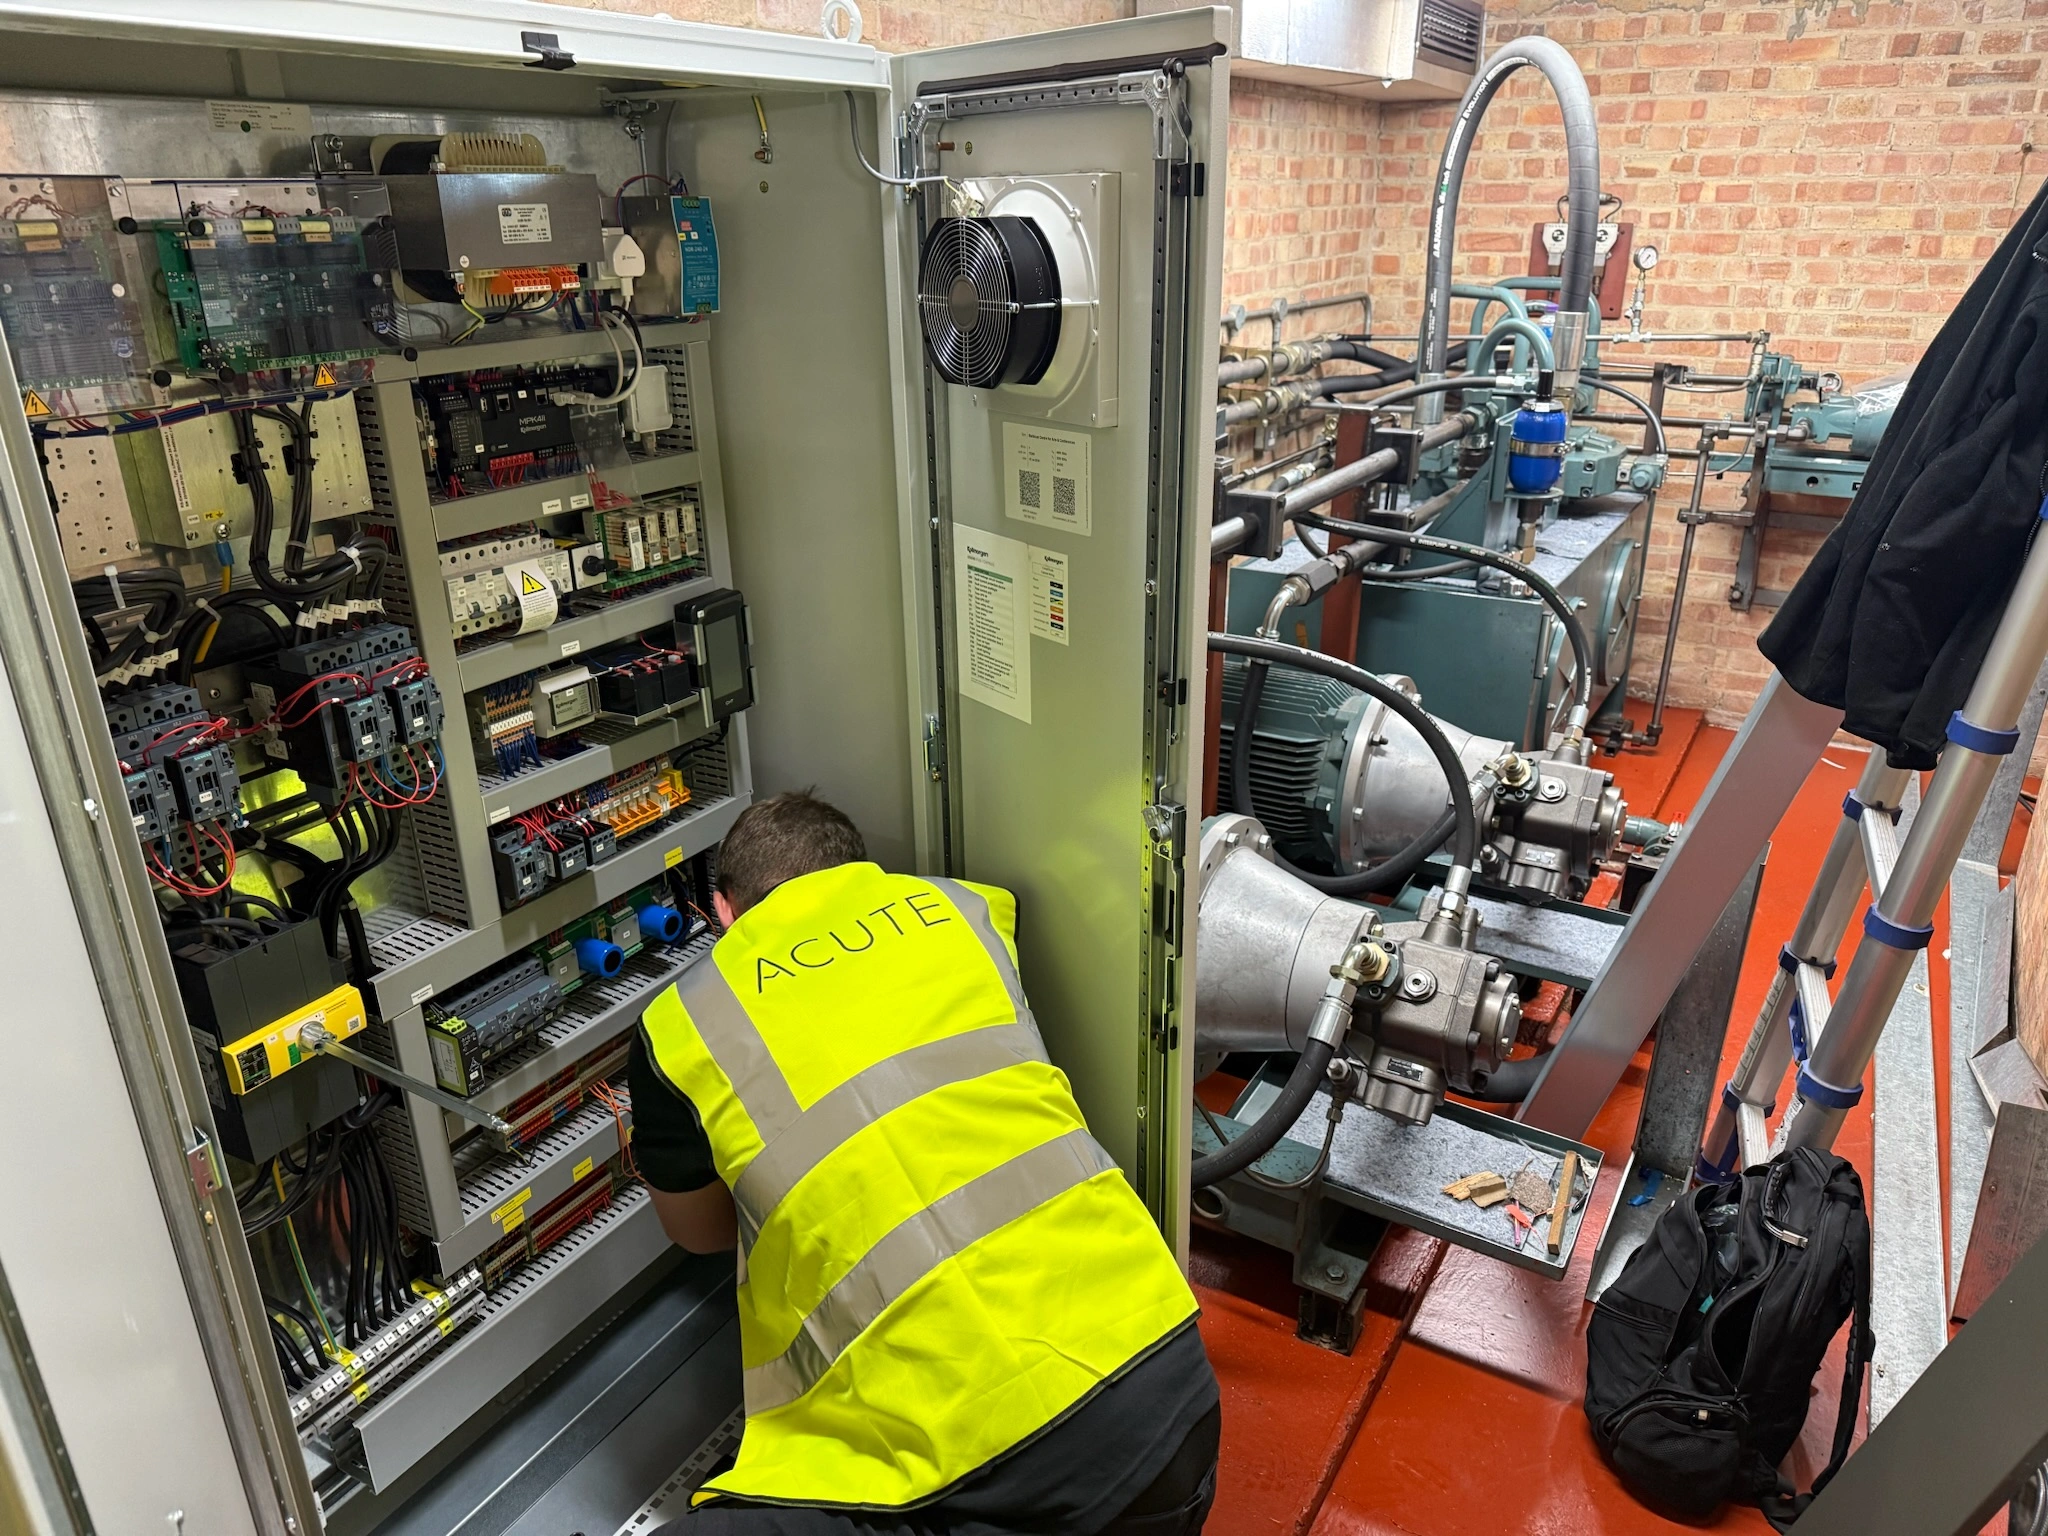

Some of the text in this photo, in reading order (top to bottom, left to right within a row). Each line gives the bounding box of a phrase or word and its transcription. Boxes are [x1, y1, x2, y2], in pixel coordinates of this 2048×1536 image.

[1462, 79, 1490, 120] EVOLUTION
[1418, 538, 1448, 550] INTERPUMP
[193, 752, 212, 761] SIEMENS
[126, 773, 146, 783] SIEMENS
[756, 891, 952, 995] ACUTE
